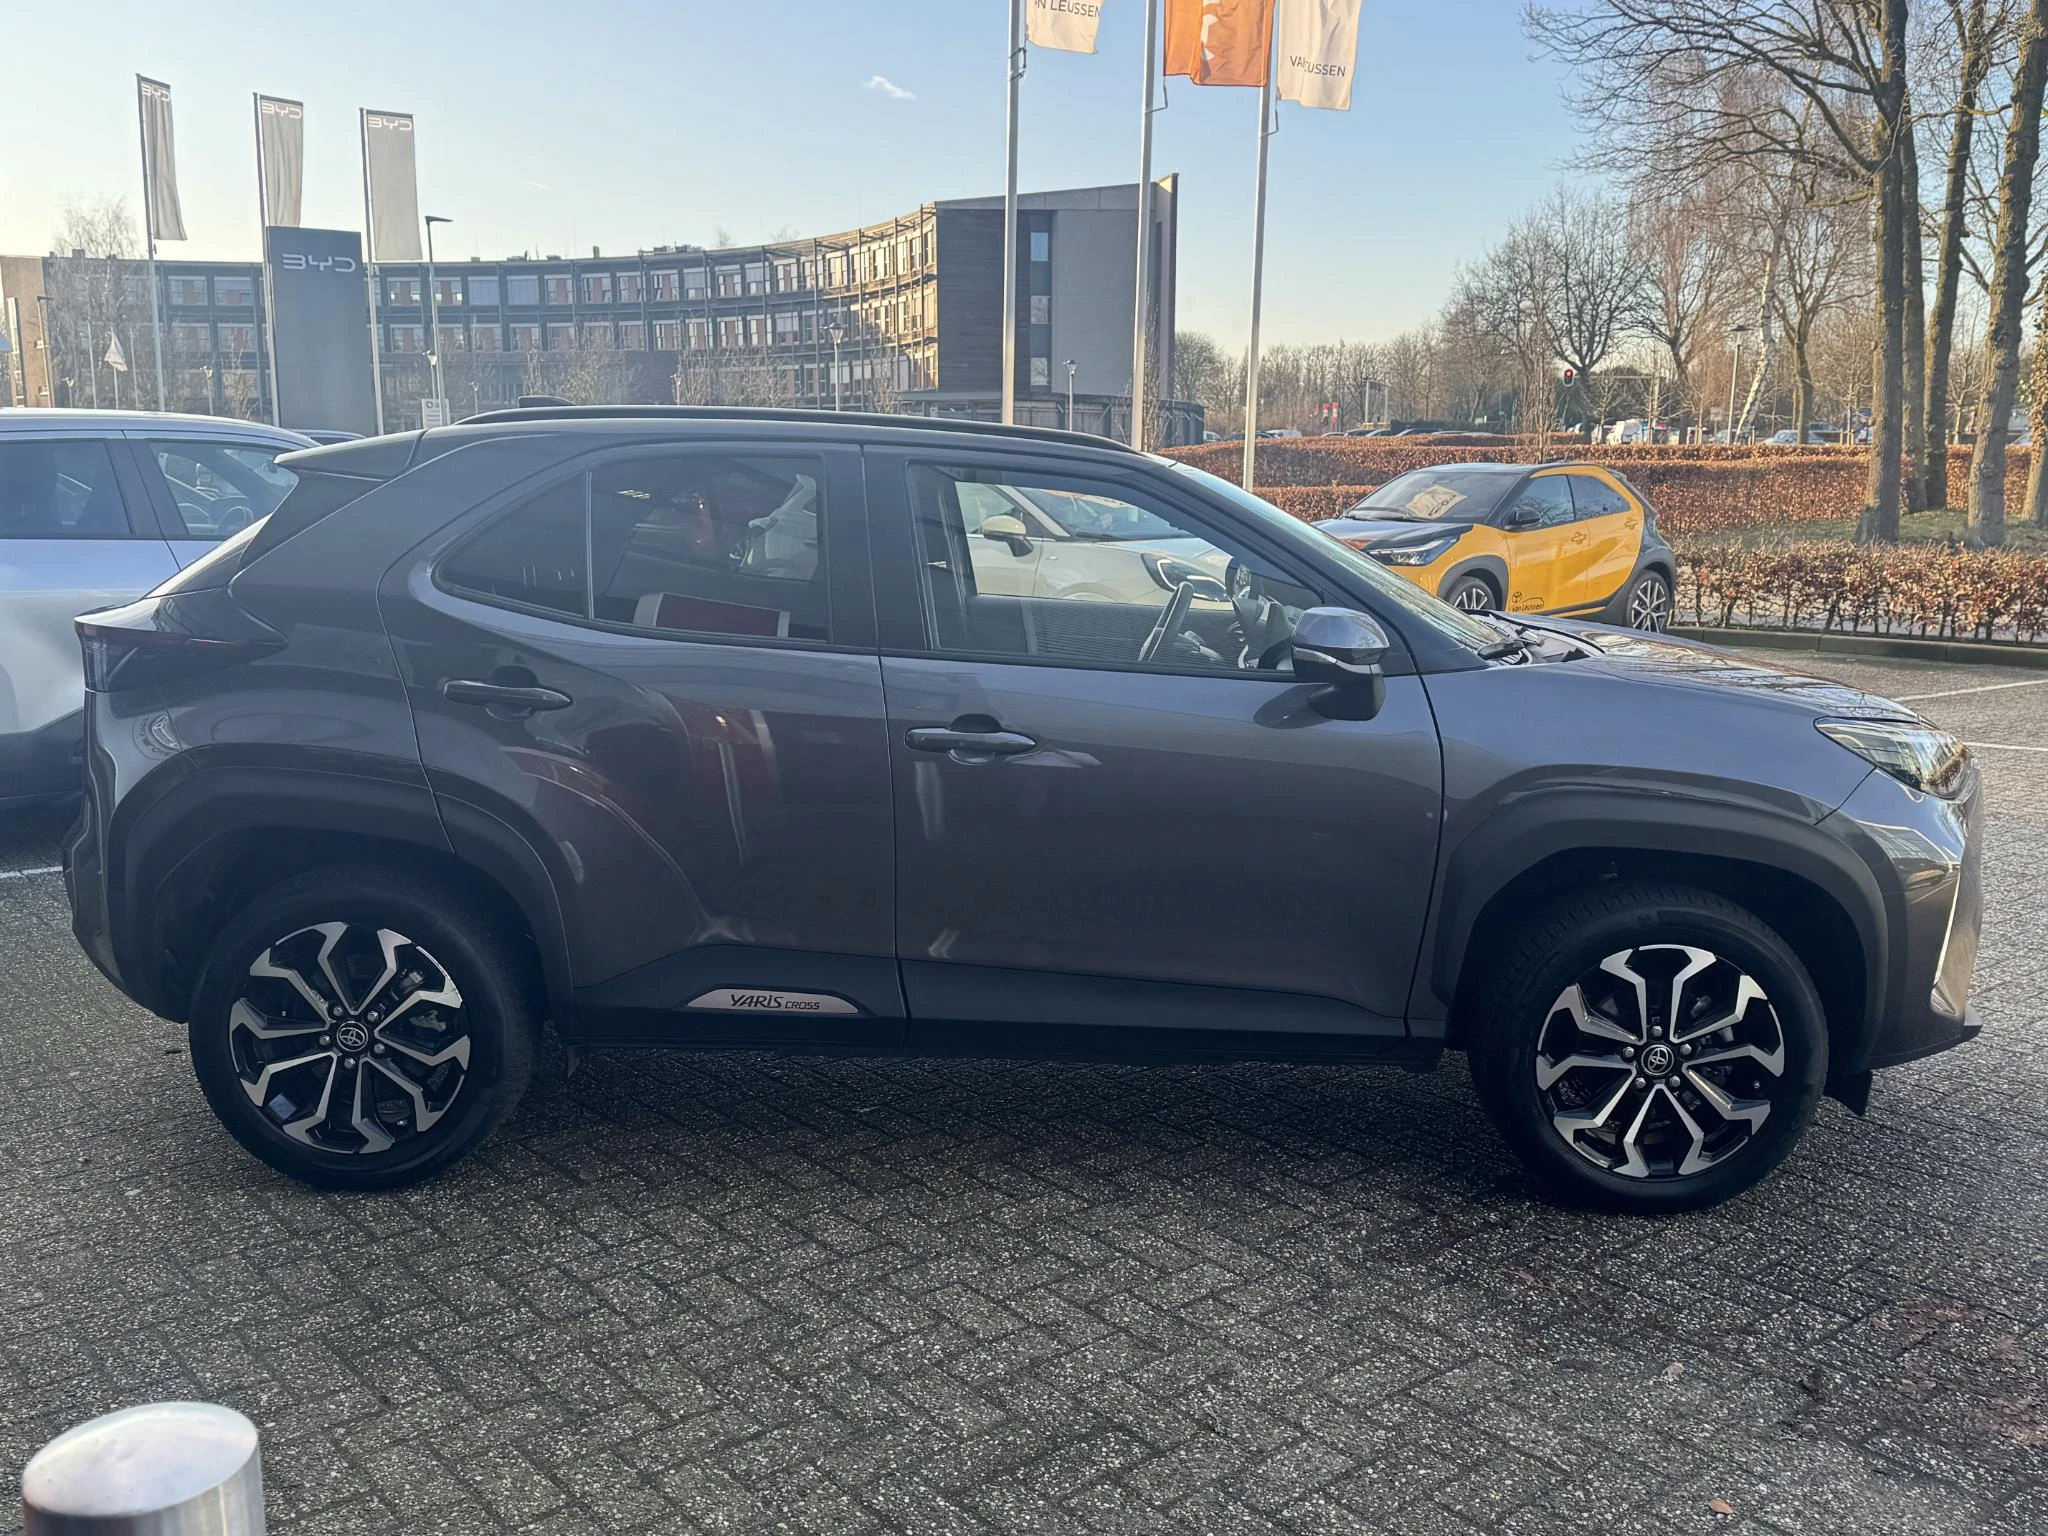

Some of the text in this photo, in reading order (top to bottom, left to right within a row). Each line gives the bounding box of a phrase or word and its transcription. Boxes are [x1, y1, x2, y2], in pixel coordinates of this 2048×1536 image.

[142, 83, 170, 101] BYD
[261, 102, 302, 119] BYD
[367, 116, 412, 131] BYD
[282, 253, 356, 273] BYD
[784, 1001, 821, 1010] CROSS
